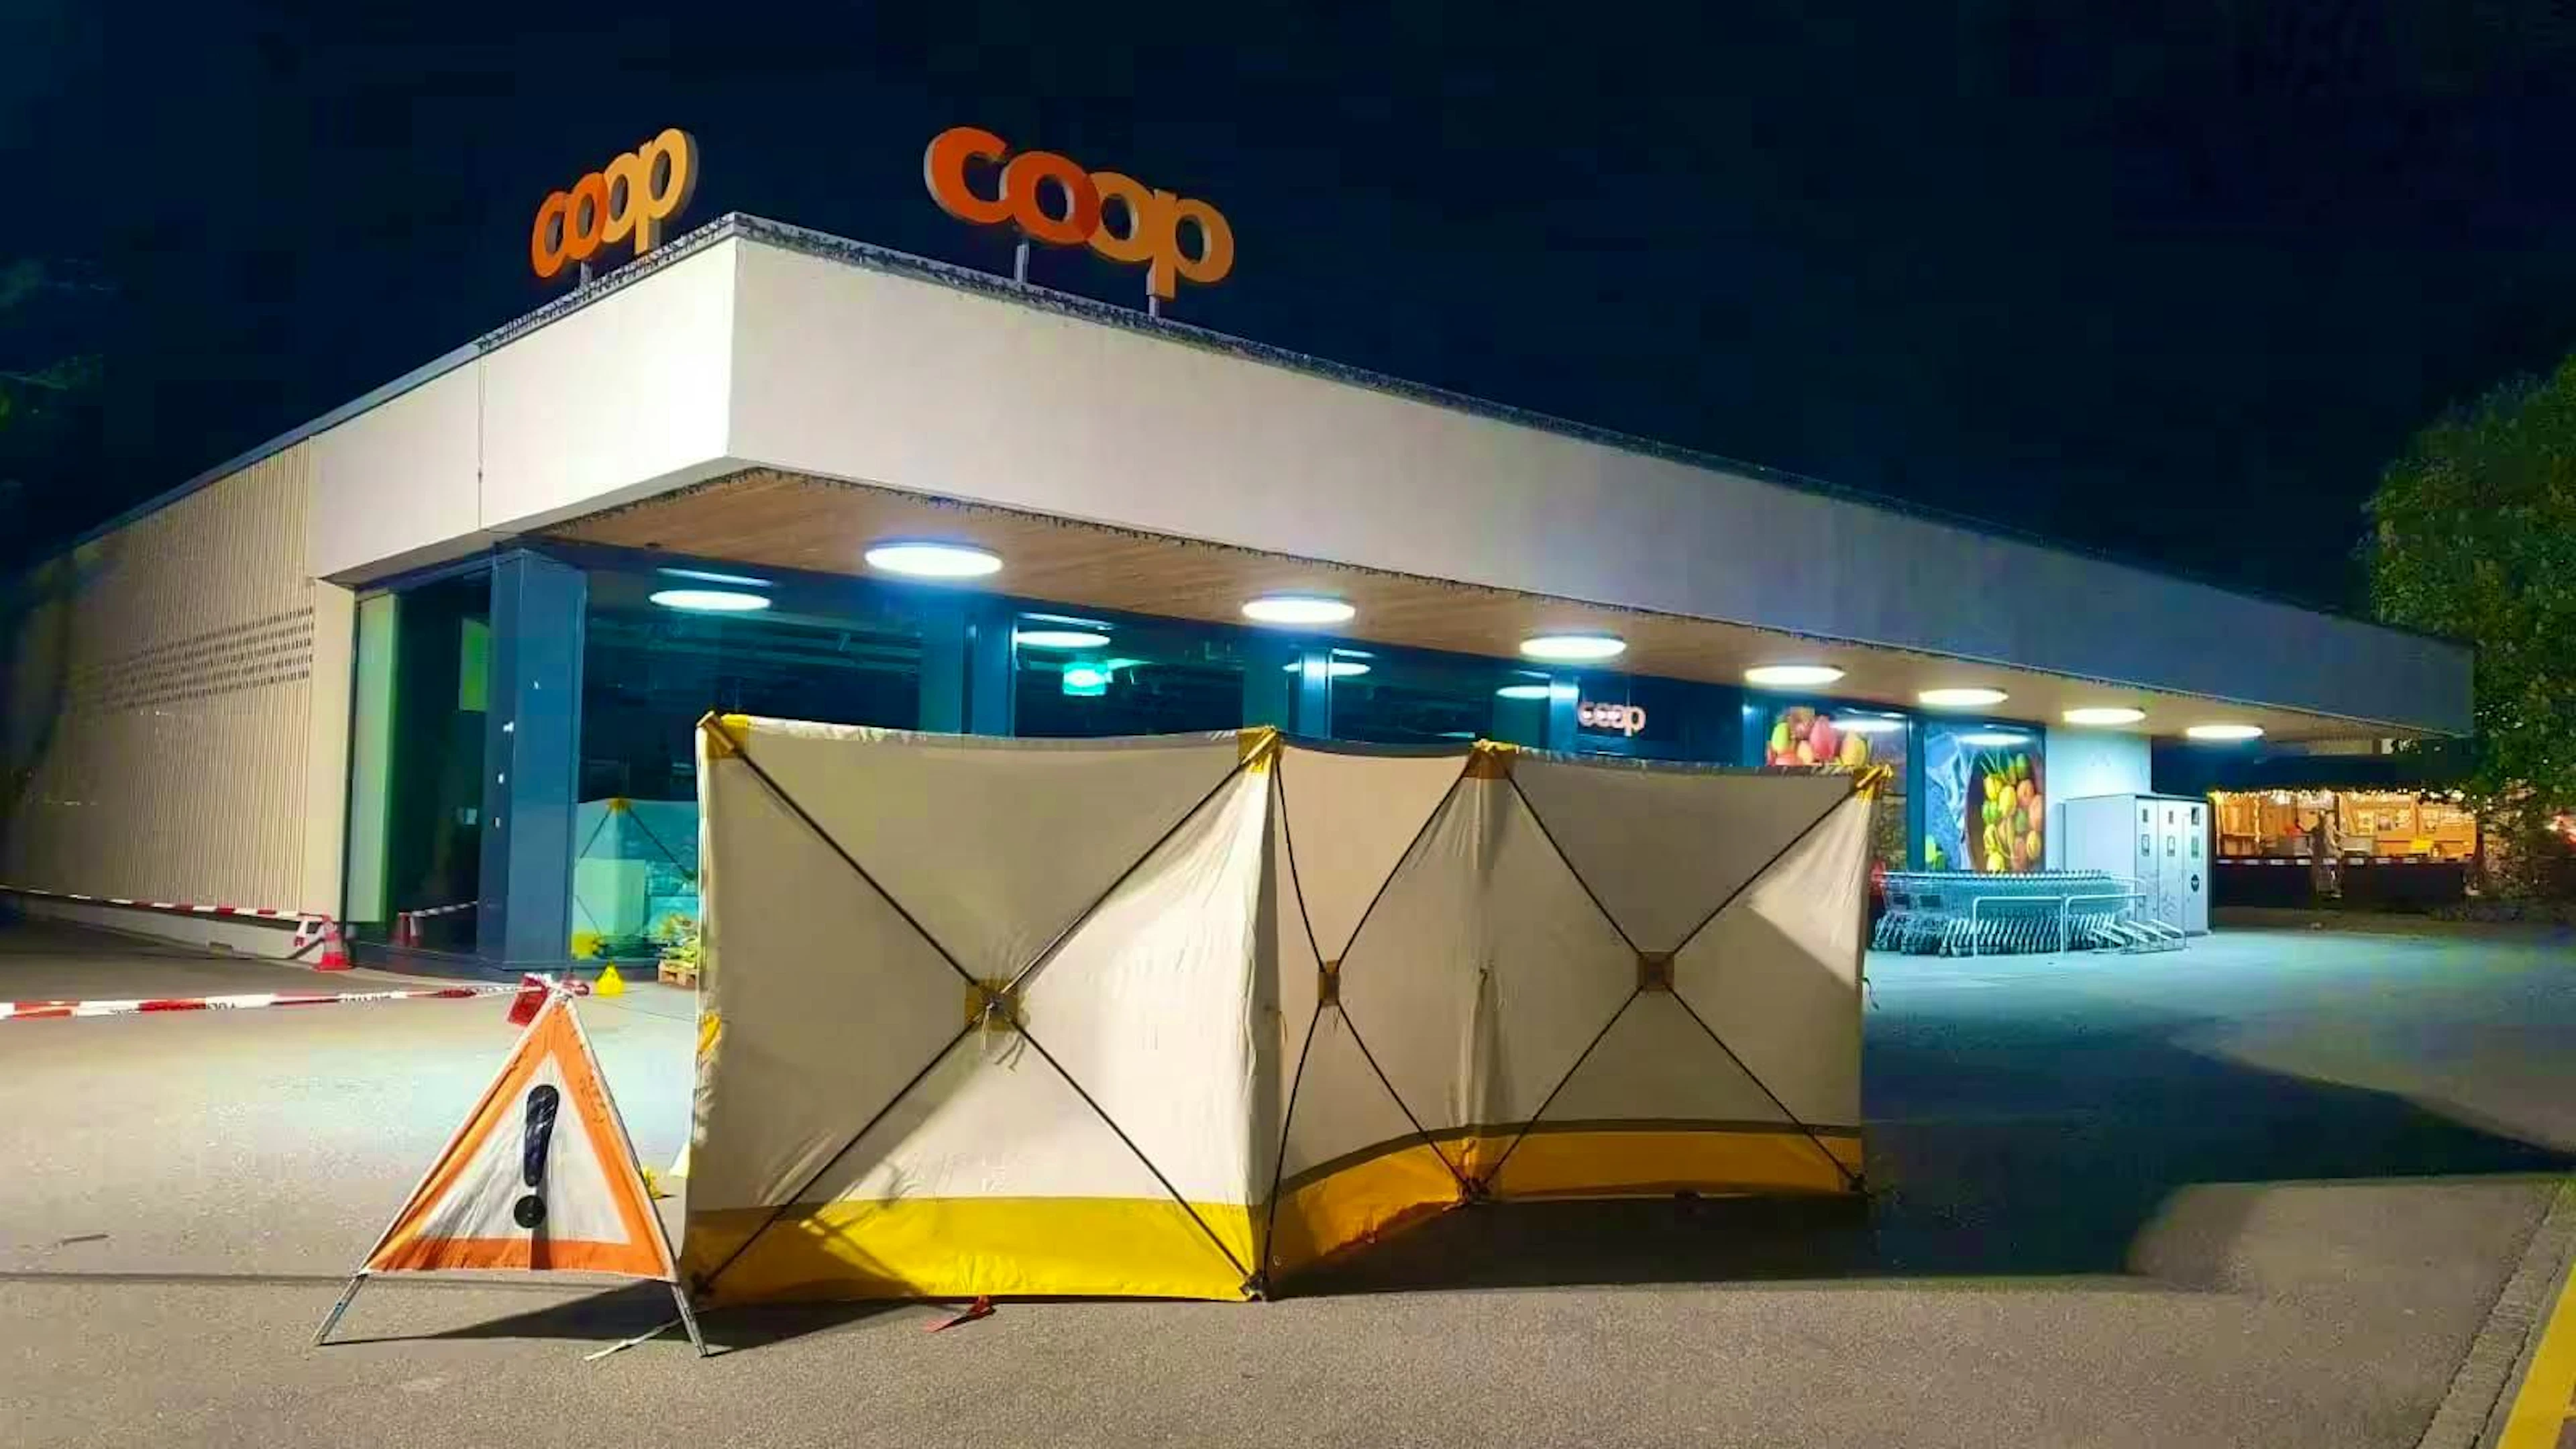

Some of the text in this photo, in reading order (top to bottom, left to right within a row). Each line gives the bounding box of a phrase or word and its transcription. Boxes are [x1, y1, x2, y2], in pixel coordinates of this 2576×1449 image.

[532, 128, 695, 276] coop
[924, 127, 1233, 299] coop
[1577, 702, 1646, 737] coop
